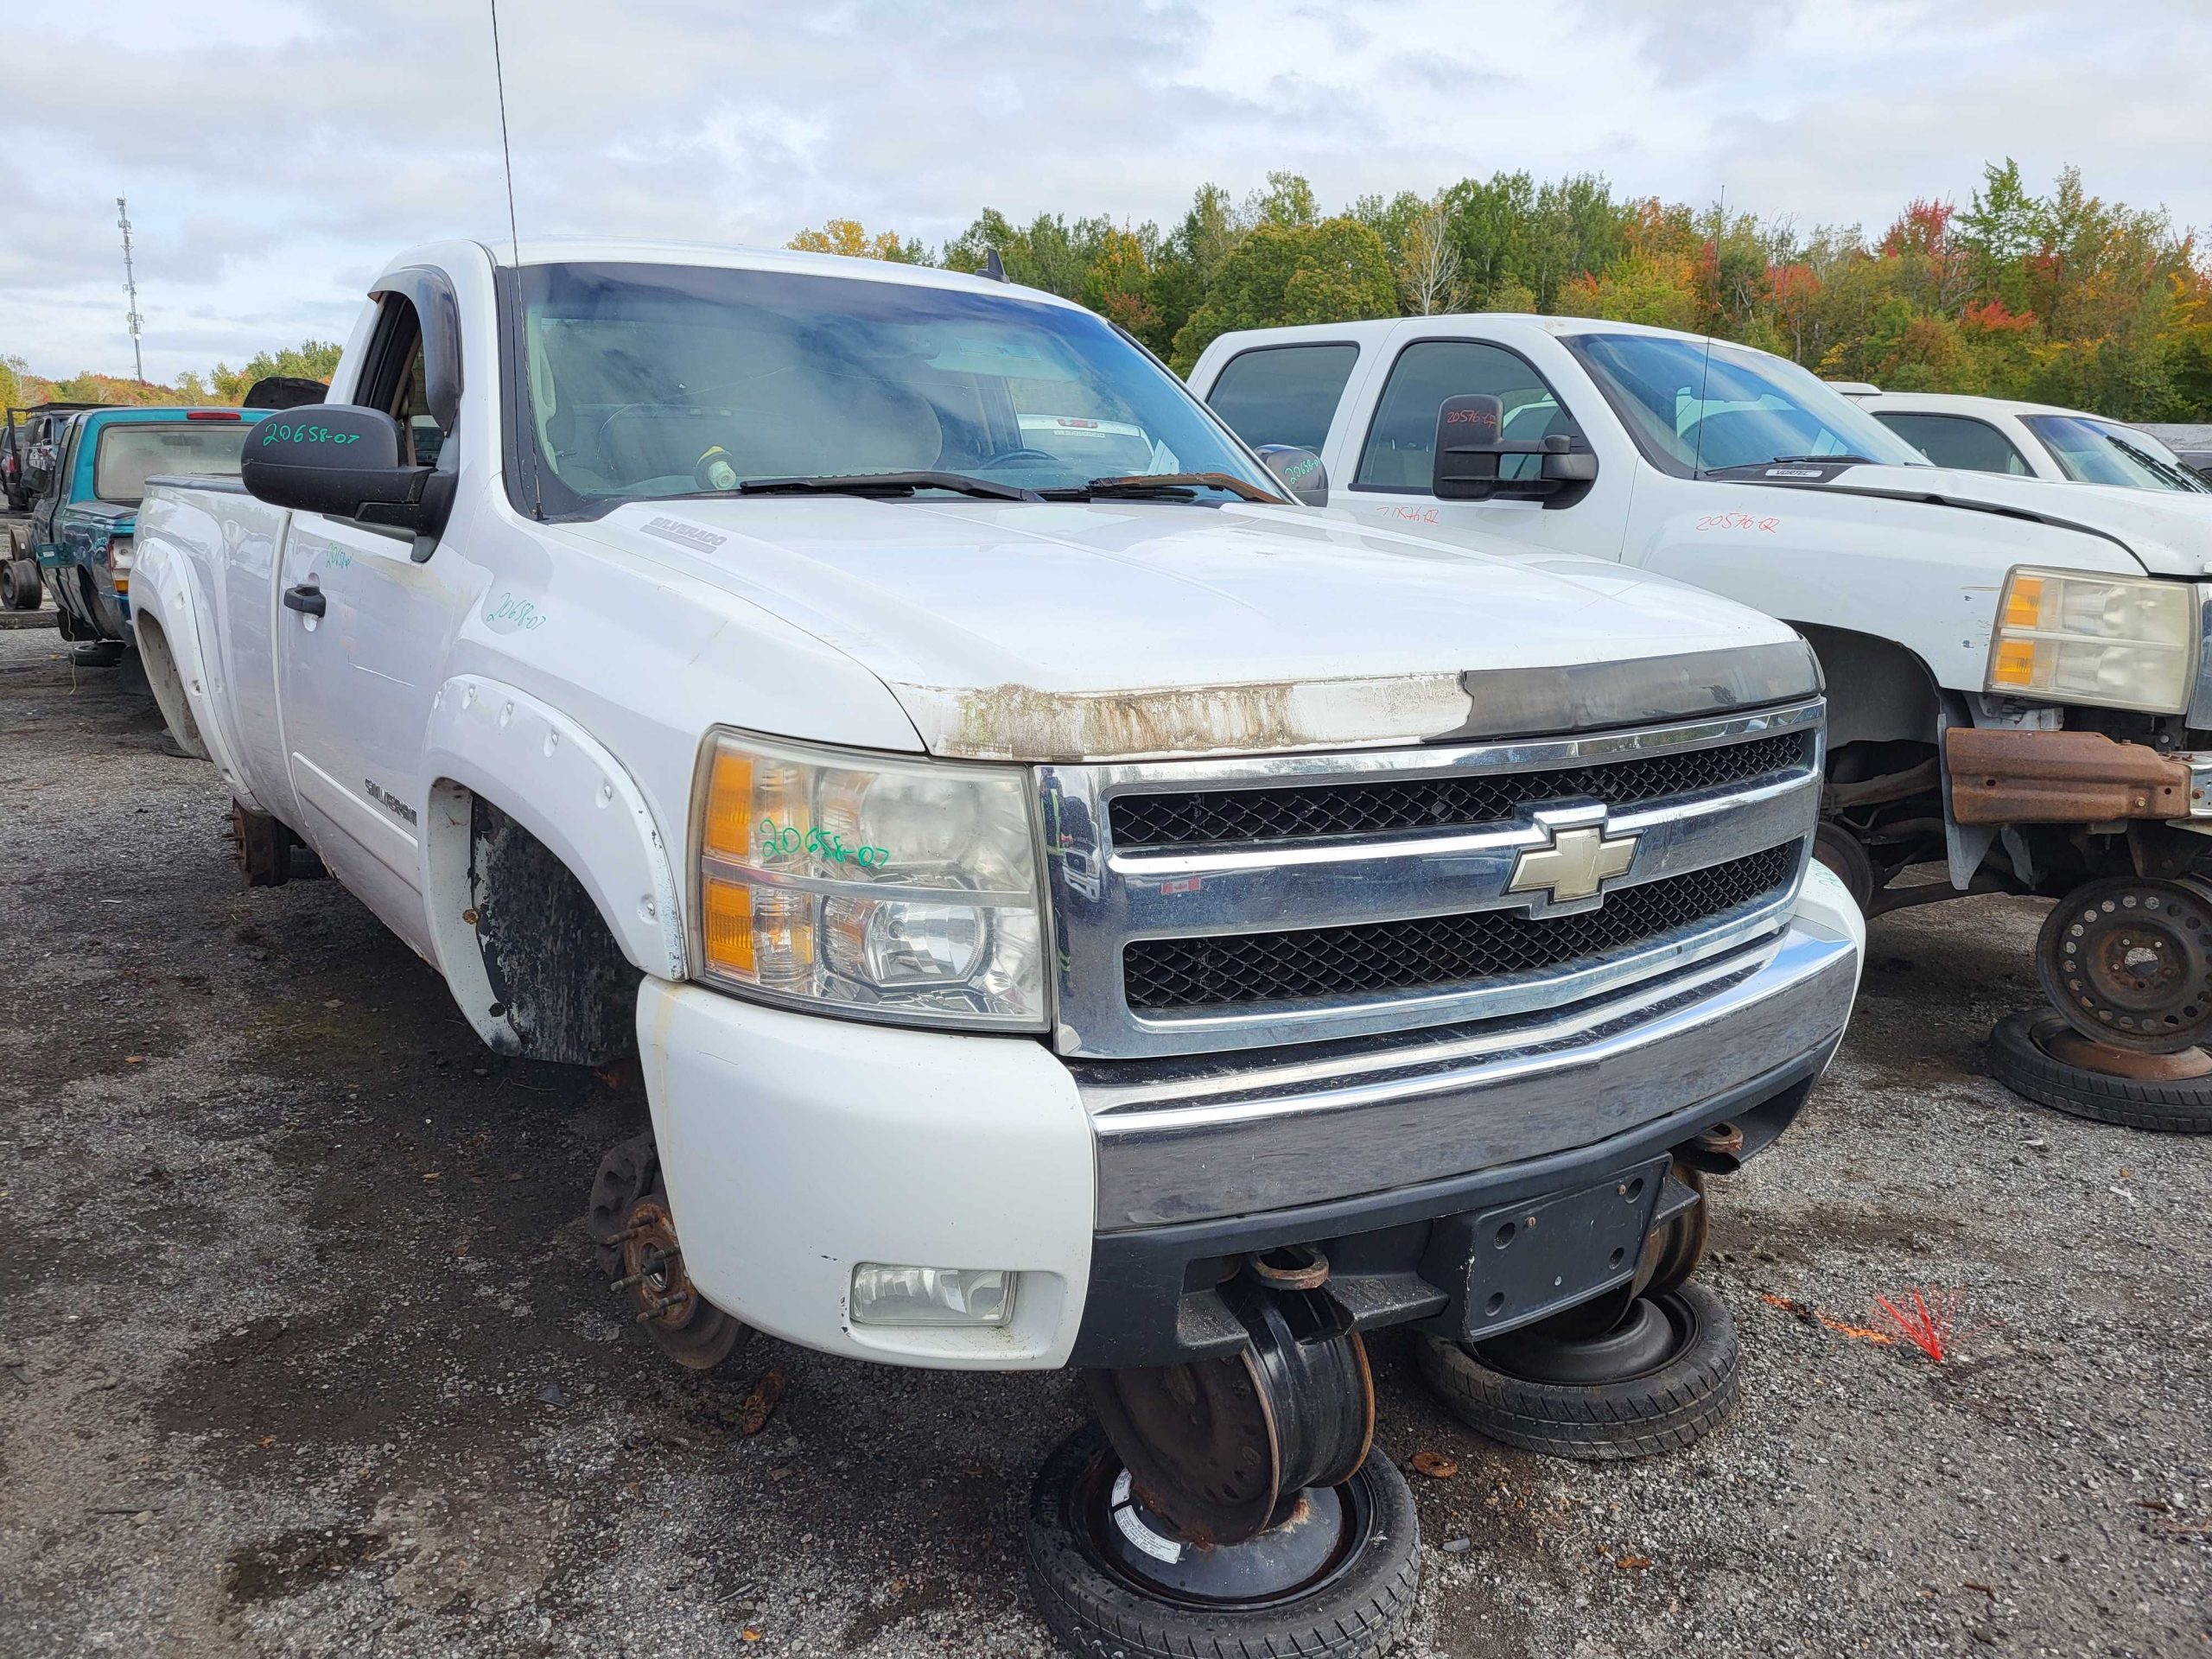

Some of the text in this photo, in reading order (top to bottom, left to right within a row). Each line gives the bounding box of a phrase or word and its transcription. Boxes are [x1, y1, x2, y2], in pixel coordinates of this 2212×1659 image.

[262, 422, 361, 447] 20658-07
[649, 517, 728, 546] SILVERADO
[760, 817, 890, 868] 20658-07
